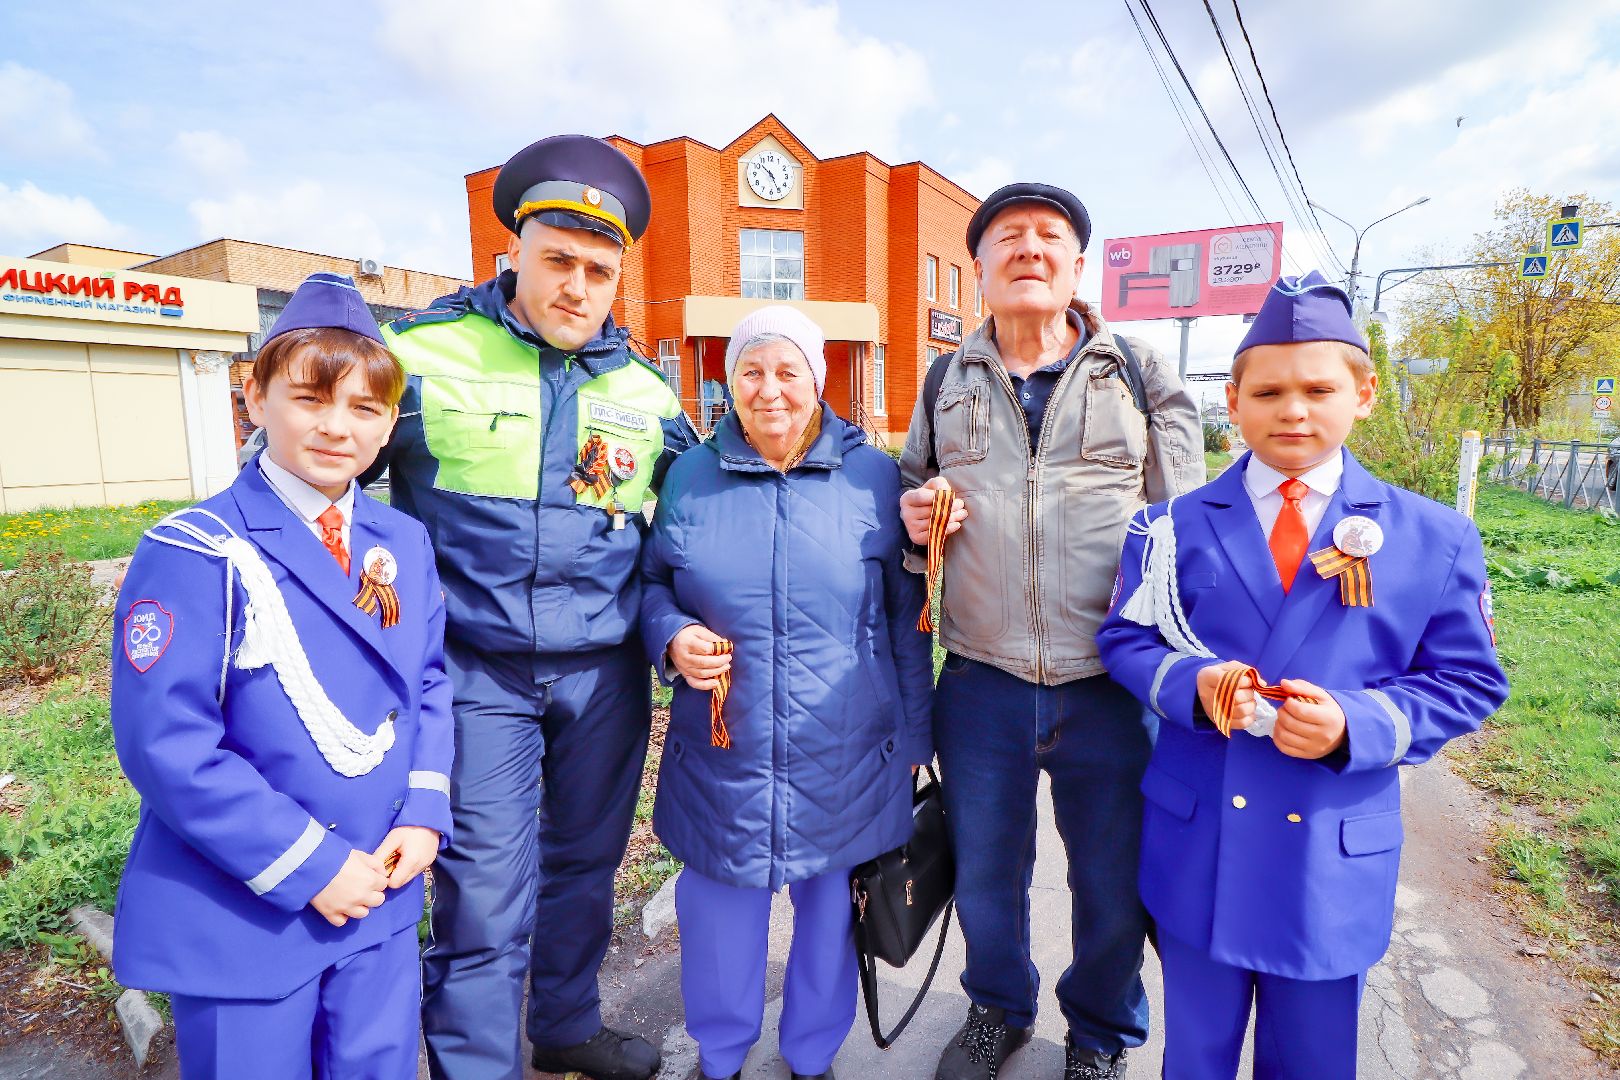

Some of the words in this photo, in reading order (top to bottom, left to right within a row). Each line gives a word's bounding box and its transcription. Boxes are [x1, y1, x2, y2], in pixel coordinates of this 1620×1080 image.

[1110, 247, 1131, 261] wb
[123, 281, 184, 307] РЯД
[2, 293, 93, 309] ФИРМЕННЫЙ
[96, 302, 157, 315] МАГАЗИН
[133, 613, 156, 623] ЮИД
